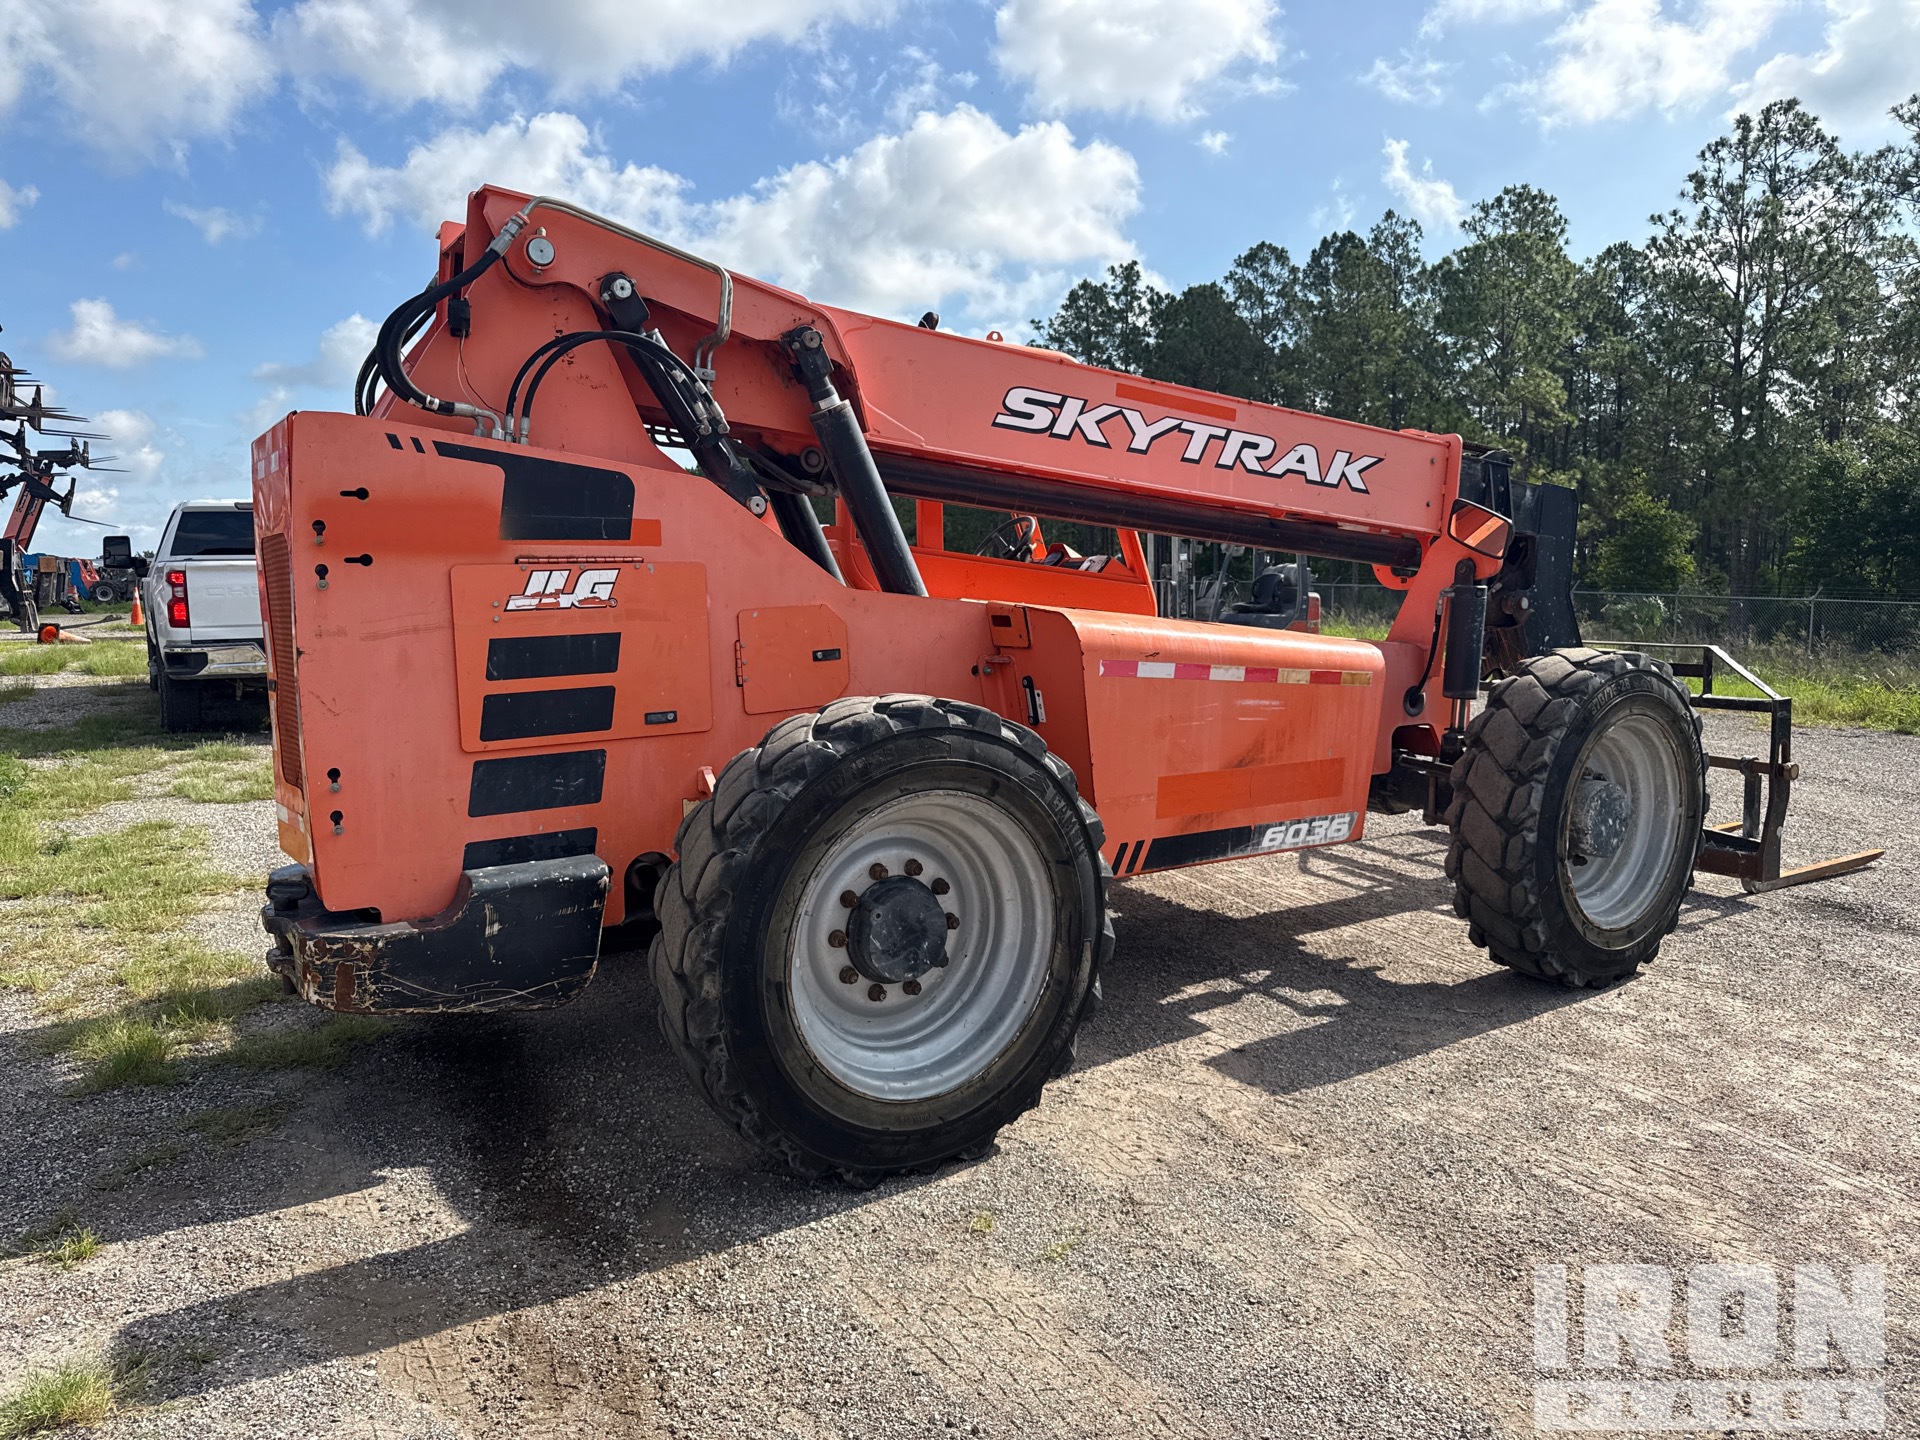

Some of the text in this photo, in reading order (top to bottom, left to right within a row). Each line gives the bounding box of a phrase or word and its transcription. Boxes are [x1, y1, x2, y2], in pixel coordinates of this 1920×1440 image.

[992, 386, 1384, 495] SKYTRAK
[504, 568, 621, 612] JLG
[1261, 816, 1351, 847] 6036
